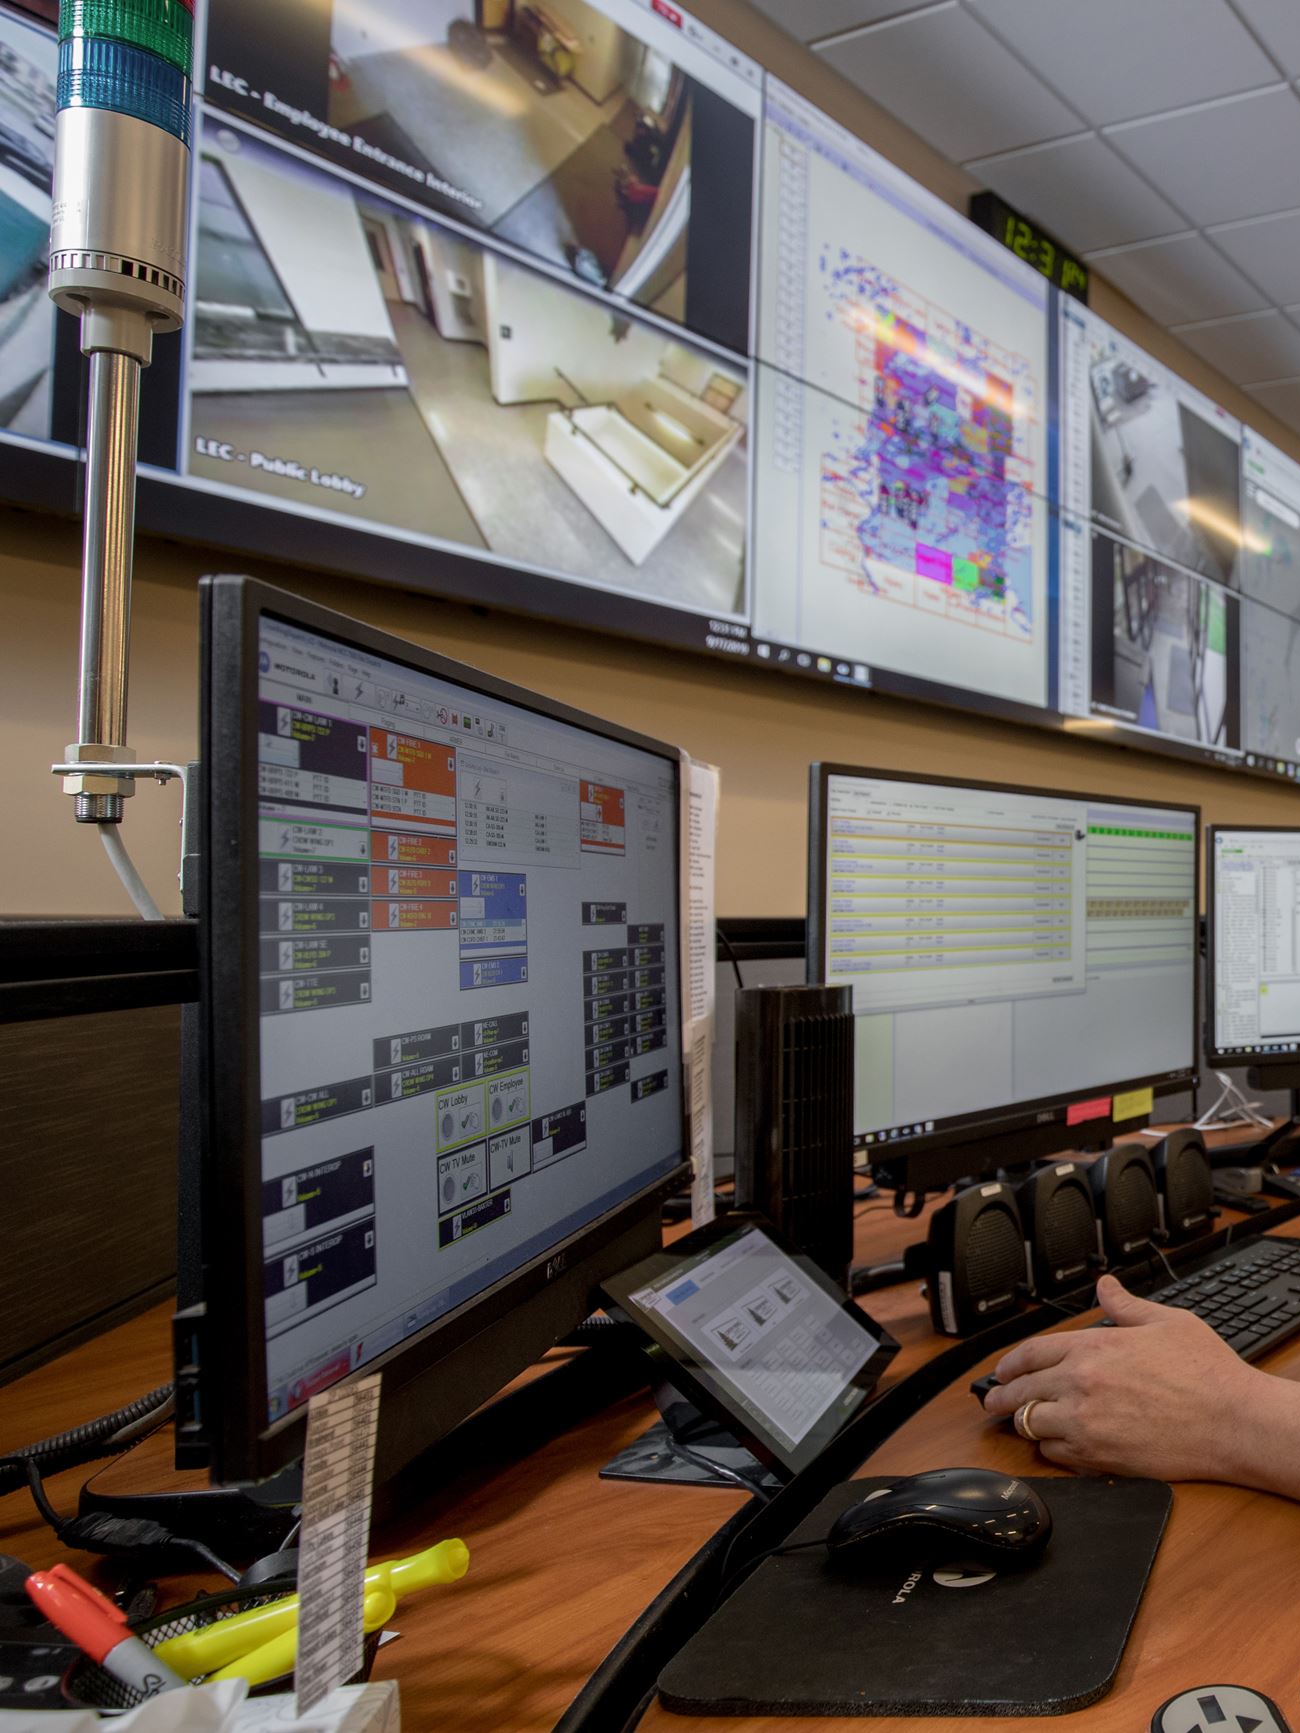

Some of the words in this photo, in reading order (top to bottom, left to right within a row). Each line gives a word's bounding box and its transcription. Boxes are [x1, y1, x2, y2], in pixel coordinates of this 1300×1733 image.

[209, 64, 249, 97] LEC
[263, 91, 353, 147] Employee
[353, 135, 426, 183] Entrance
[195, 436, 235, 462] LEC
[250, 451, 309, 481] Public
[310, 467, 368, 499] Lobby
[489, 1082, 499, 1095] CW
[499, 1076, 524, 1092] Employee
[438, 1098, 449, 1111] CW
[450, 1093, 468, 1108] Lobby
[439, 1161, 450, 1174] CW
[461, 1152, 475, 1165] Mute
